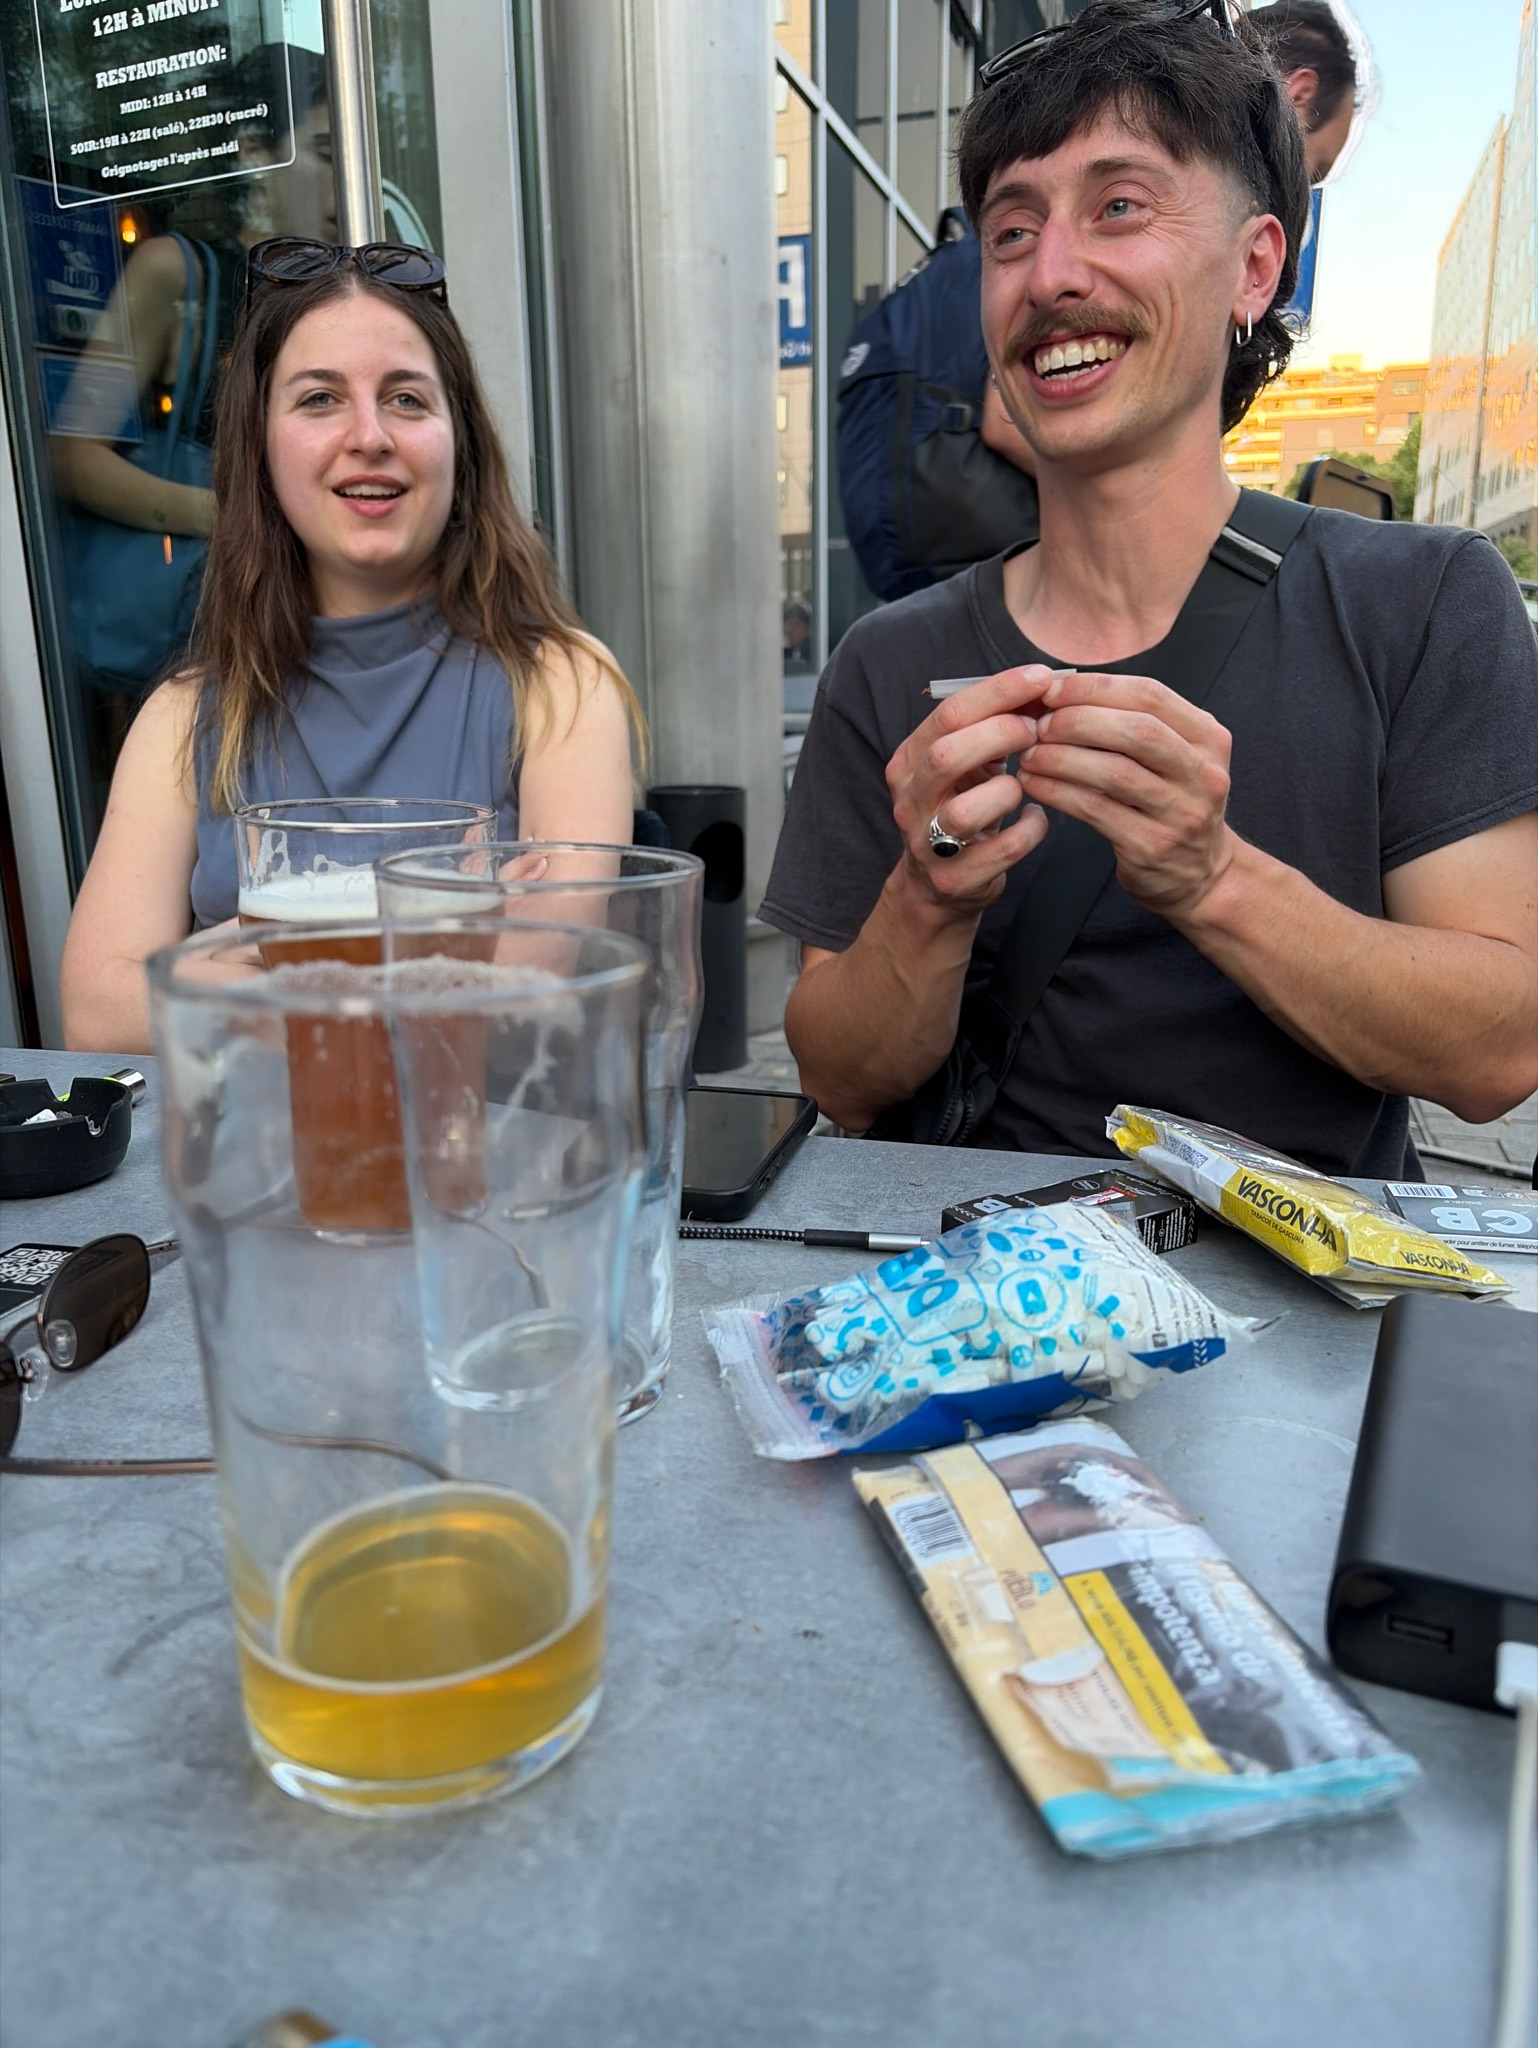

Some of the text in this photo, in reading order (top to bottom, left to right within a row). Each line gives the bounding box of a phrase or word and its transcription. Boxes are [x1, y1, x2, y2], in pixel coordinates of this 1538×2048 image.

[92, 11, 129, 37] 12H
[131, 8, 145, 28] à
[96, 45, 227, 89] RESTAURATION:
[120, 85, 208, 114] MIDI: 12H à 14H
[121, 132, 129, 145] à
[129, 127, 151, 143] 22H
[225, 103, 269, 124] (sucré)
[101, 140, 239, 178] Grignotages l'après midi
[1237, 1175, 1338, 1252] VASCONHA
[1399, 1250, 1471, 1276] VASCONHA
[1127, 1562, 1223, 1687] impotenza
